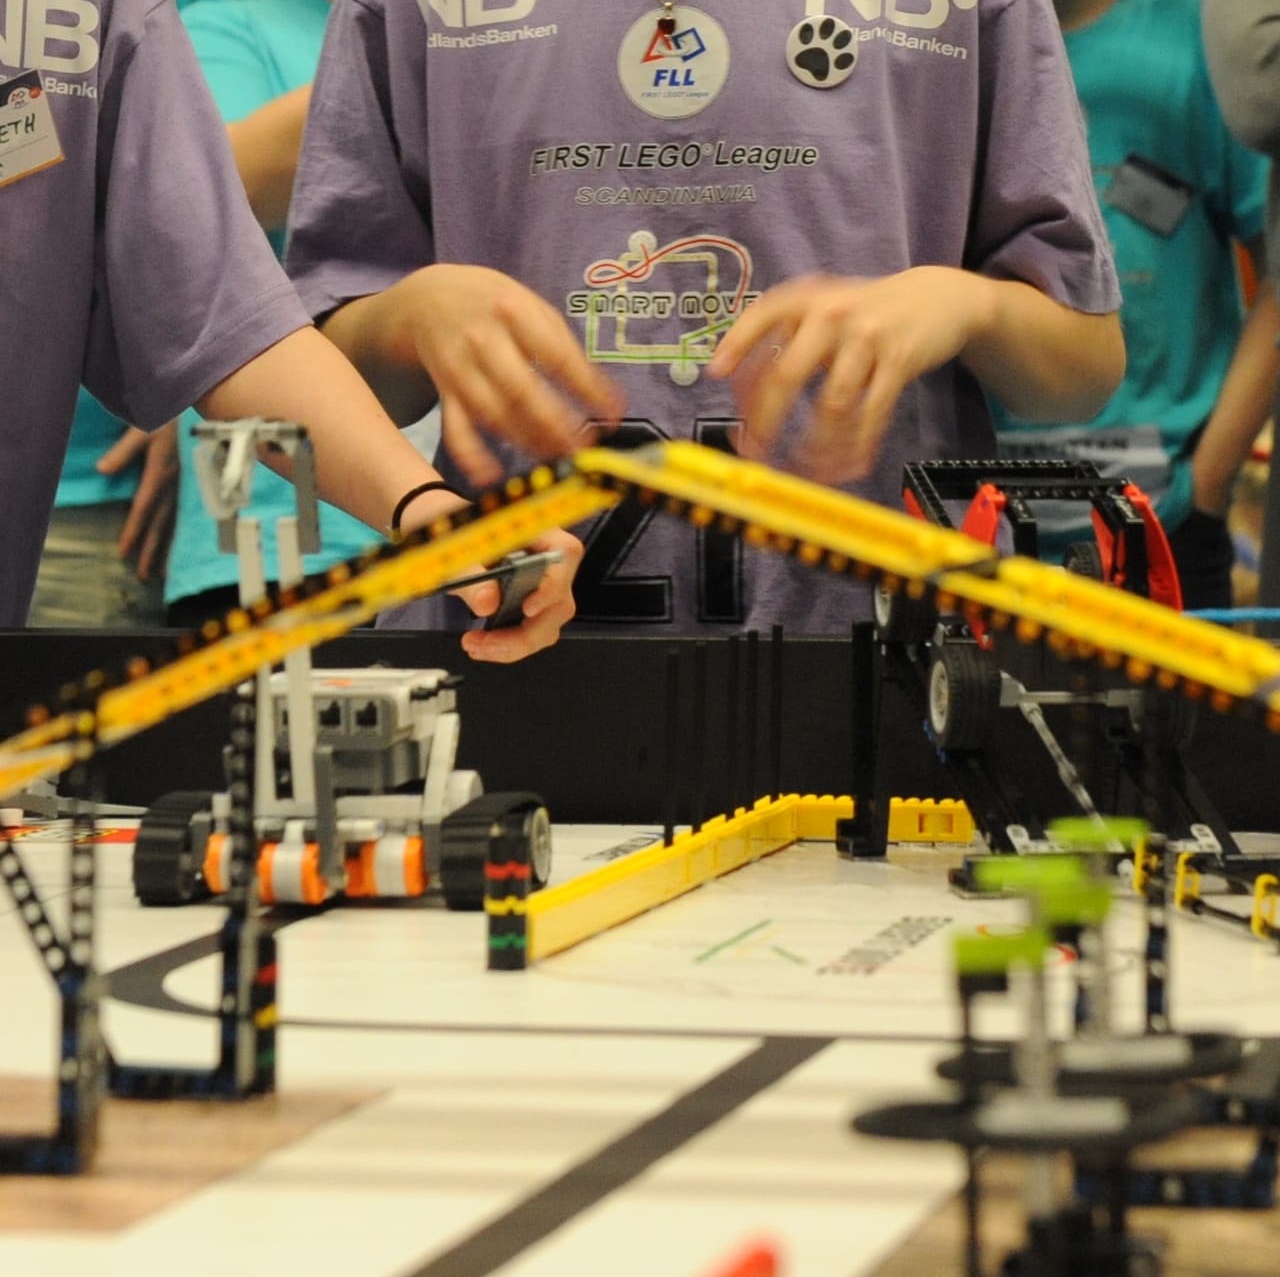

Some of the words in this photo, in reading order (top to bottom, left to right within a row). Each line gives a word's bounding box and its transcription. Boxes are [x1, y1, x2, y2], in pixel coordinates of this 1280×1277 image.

[652, 68, 696, 87] FLL
[530, 143, 612, 176] FIRST
[714, 141, 820, 171] League
[575, 184, 757, 206] SCANDINAVIA
